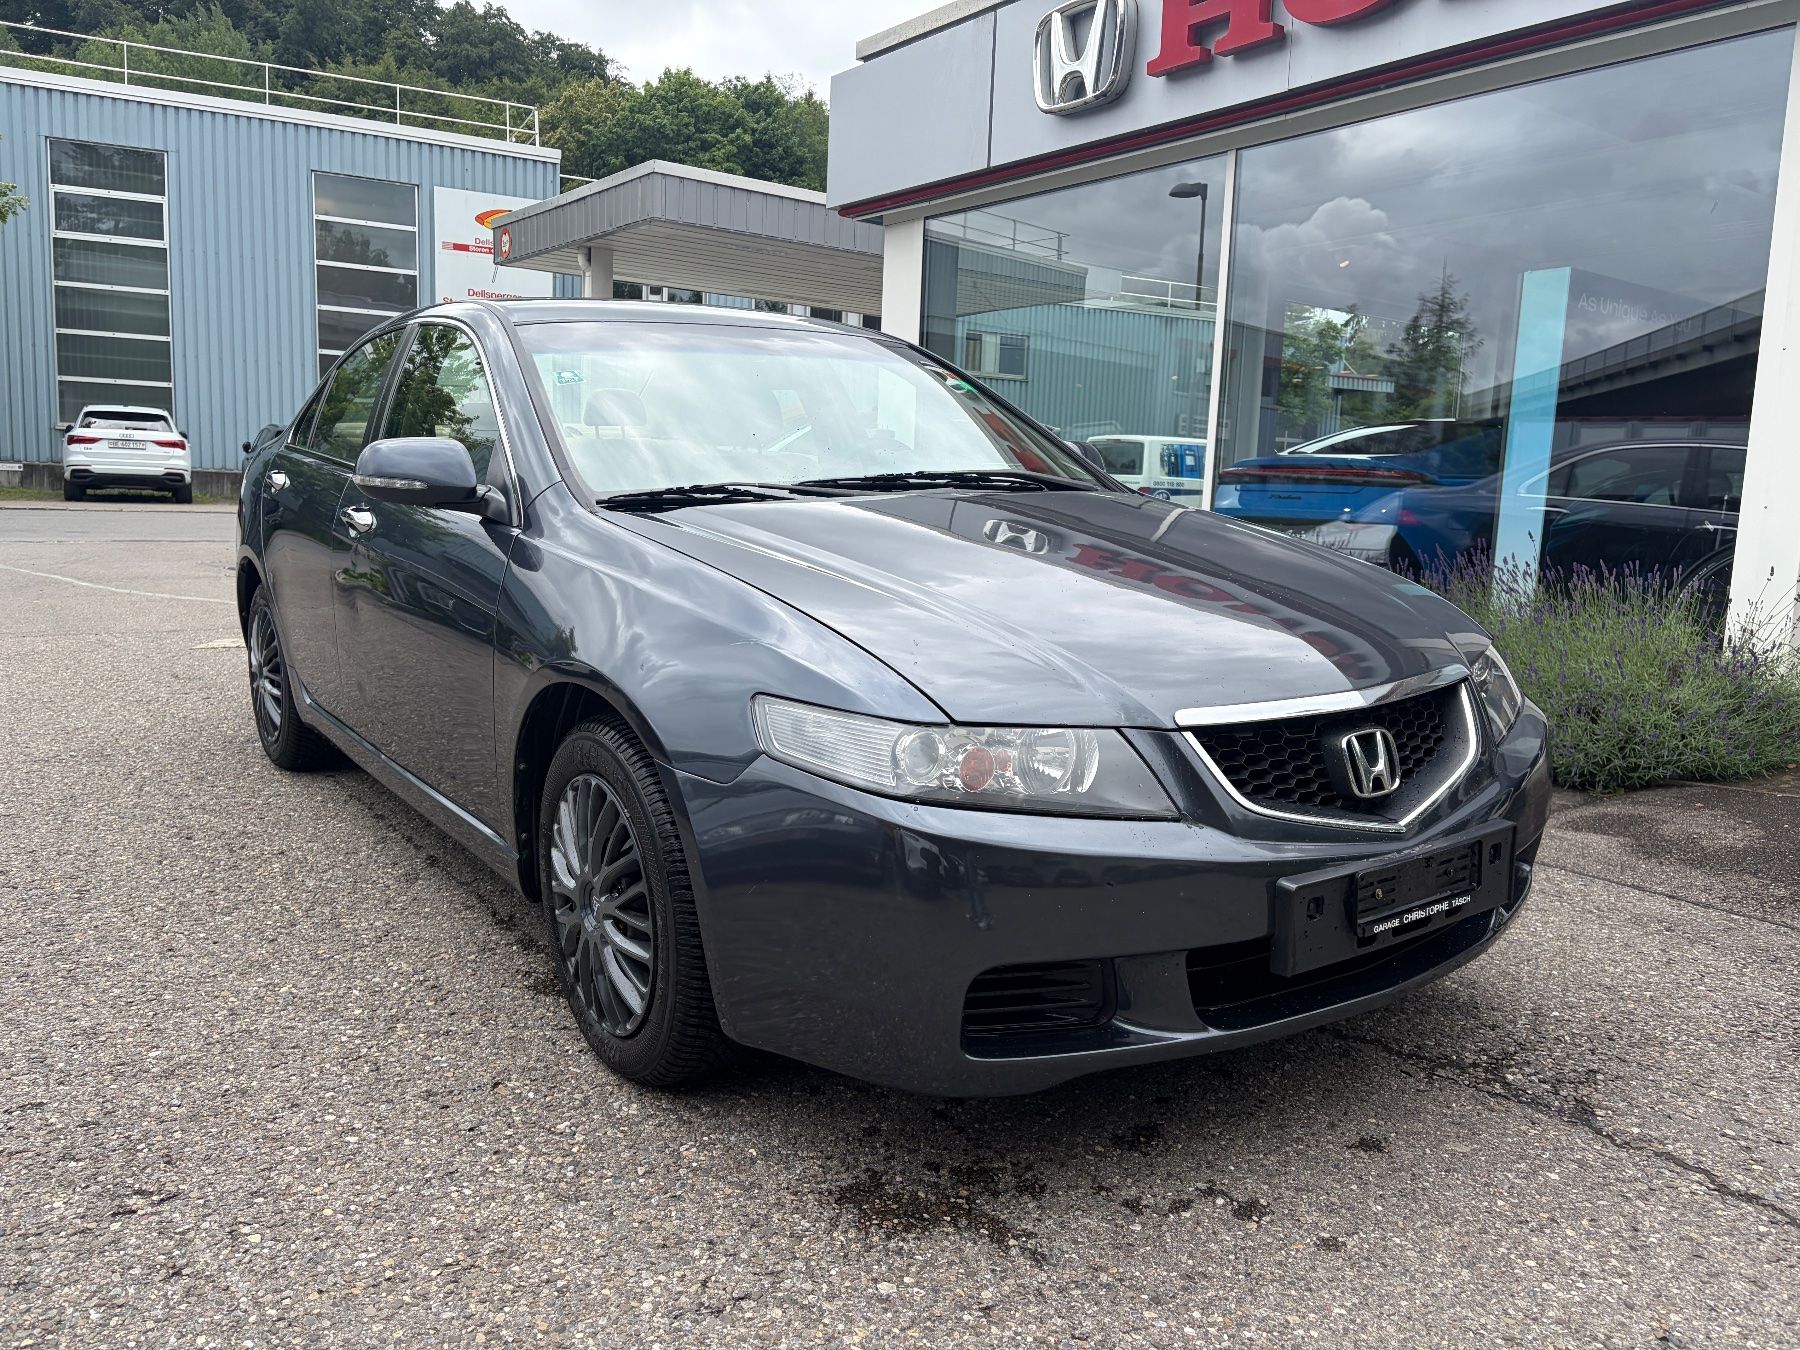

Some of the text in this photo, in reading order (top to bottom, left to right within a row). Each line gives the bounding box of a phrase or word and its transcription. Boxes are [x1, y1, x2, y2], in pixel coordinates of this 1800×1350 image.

[1578, 292, 1597, 312] As
[1600, 297, 1648, 324] Unique
[1373, 918, 1400, 934] GARAGE
[1403, 901, 1449, 924] CHRISTOPHE
